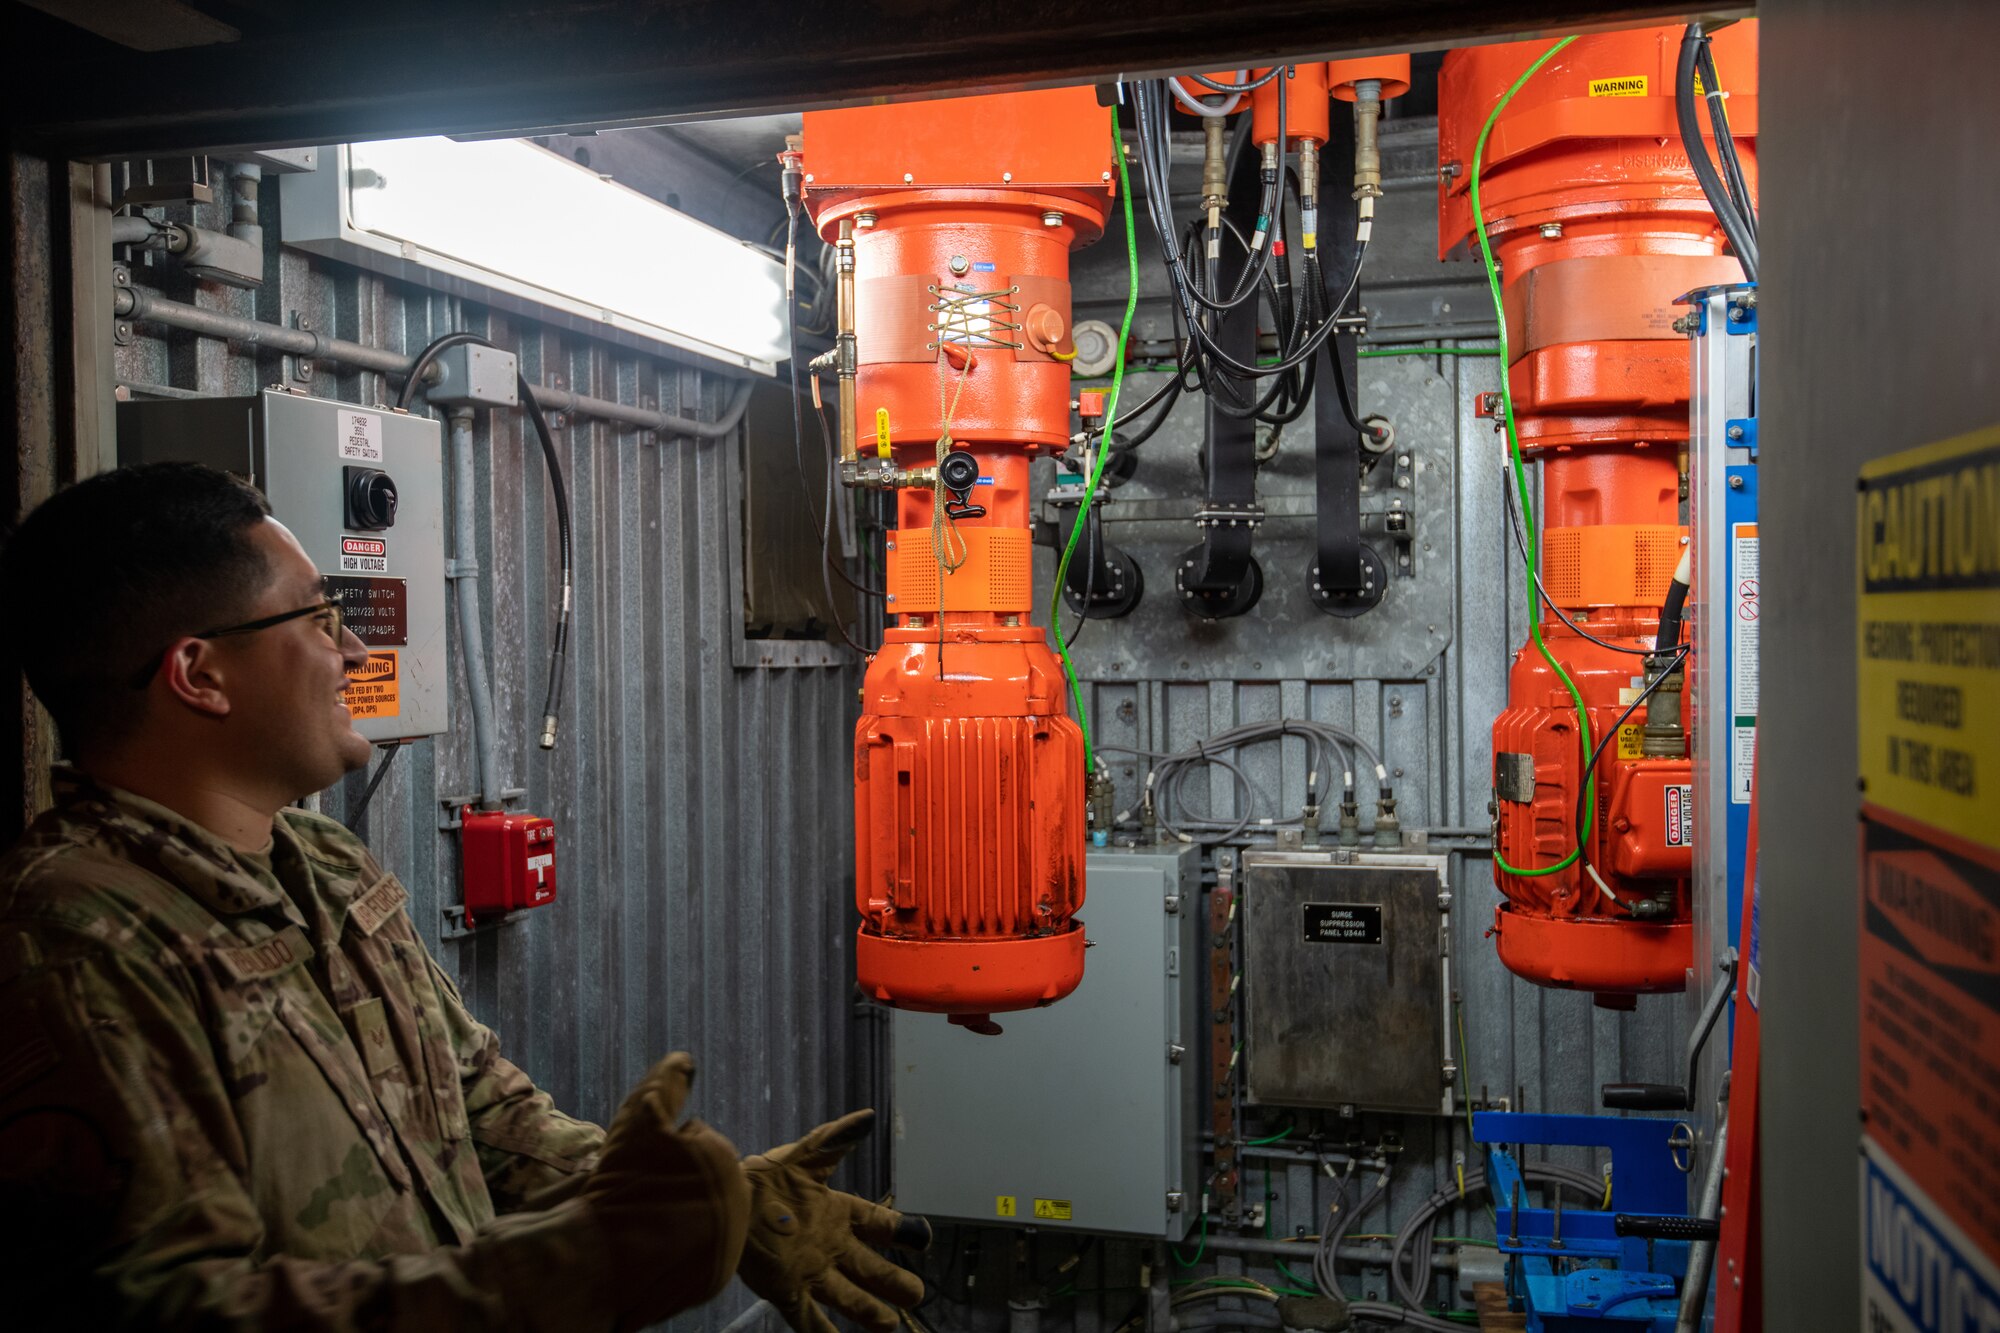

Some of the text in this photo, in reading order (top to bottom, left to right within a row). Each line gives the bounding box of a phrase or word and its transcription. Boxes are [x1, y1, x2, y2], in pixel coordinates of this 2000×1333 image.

[1593, 80, 1644, 93] WARNING
[1622, 153, 1692, 168] DISENGAG
[344, 446, 379, 459] SAFETY SWITCH
[1864, 461, 2000, 583] CAUTION
[346, 541, 381, 552] DANGER
[344, 557, 385, 571] HIGH VOLTAGE
[335, 588, 396, 599] SAFETY SWITCH
[378, 607, 396, 617] VOLTS
[355, 686, 366, 695] FED
[366, 685, 373, 694] BY
[373, 684, 385, 694] TWO
[357, 695, 375, 704] POWER
[375, 694, 396, 703] SOURCES
[353, 704, 378, 715] (DP4, DP5)
[1670, 793, 1679, 839] DANGER
[1682, 788, 1692, 843] HIGH VOLTAGE
[534, 859, 547, 867] PULL
[370, 878, 406, 914] FORCE
[1331, 911, 1353, 919] SURGE
[1320, 920, 1365, 928] SUPPRESSION
[1320, 929, 1341, 937] PANEL
